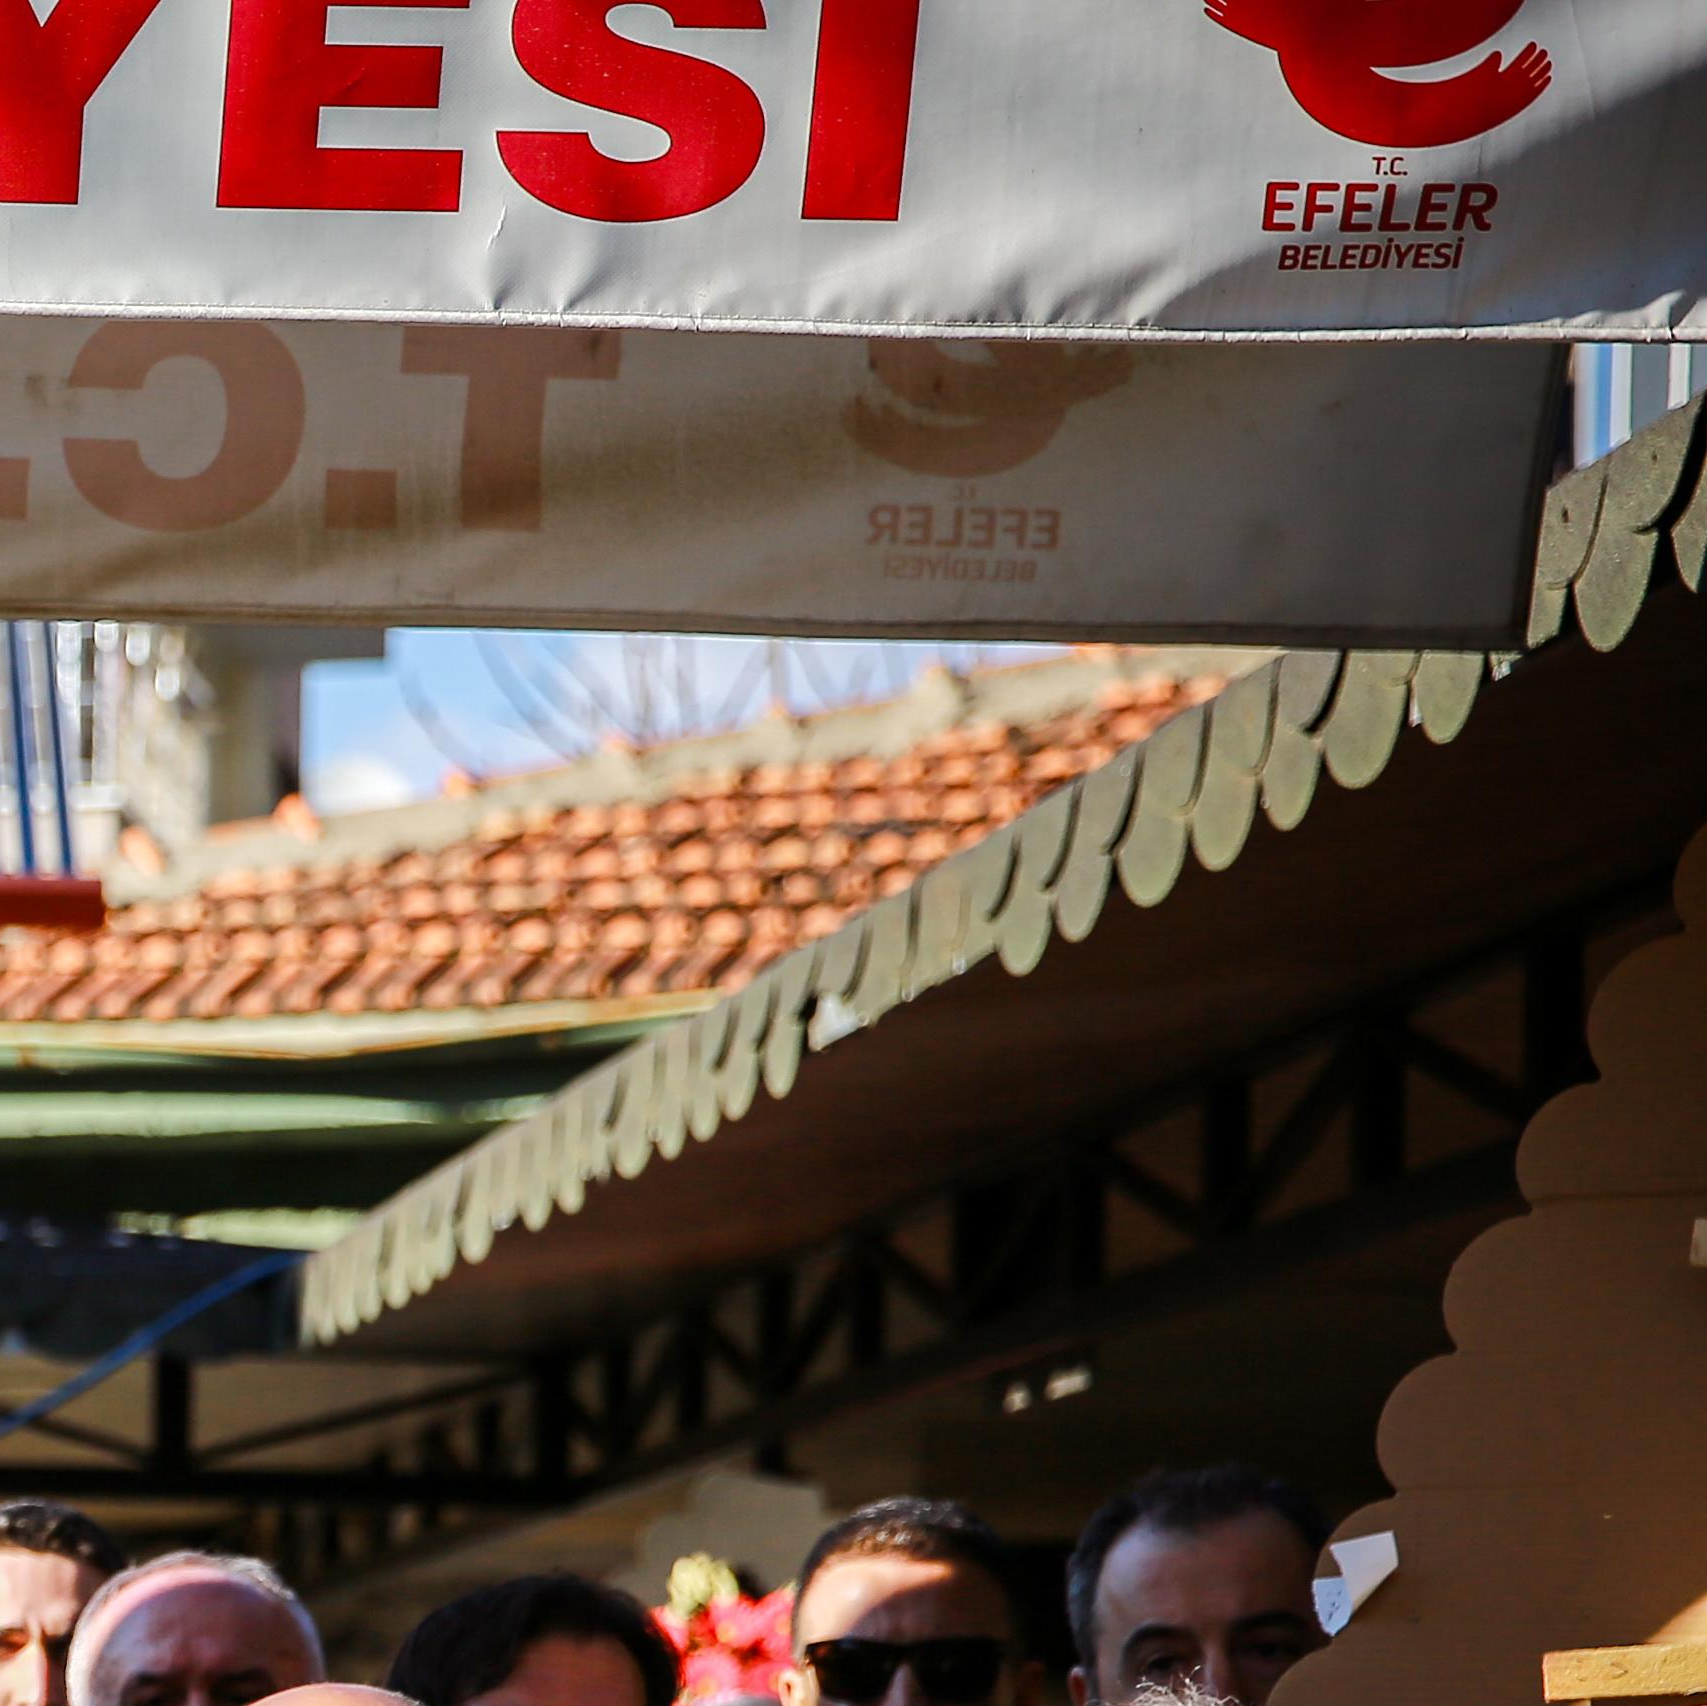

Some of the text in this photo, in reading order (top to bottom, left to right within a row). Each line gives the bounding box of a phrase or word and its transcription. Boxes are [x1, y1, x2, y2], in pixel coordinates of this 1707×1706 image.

[1372, 157, 1408, 175] T.C.
[1262, 182, 1498, 232] EFELER
[1278, 237, 1464, 270] BELEDİYESİ
